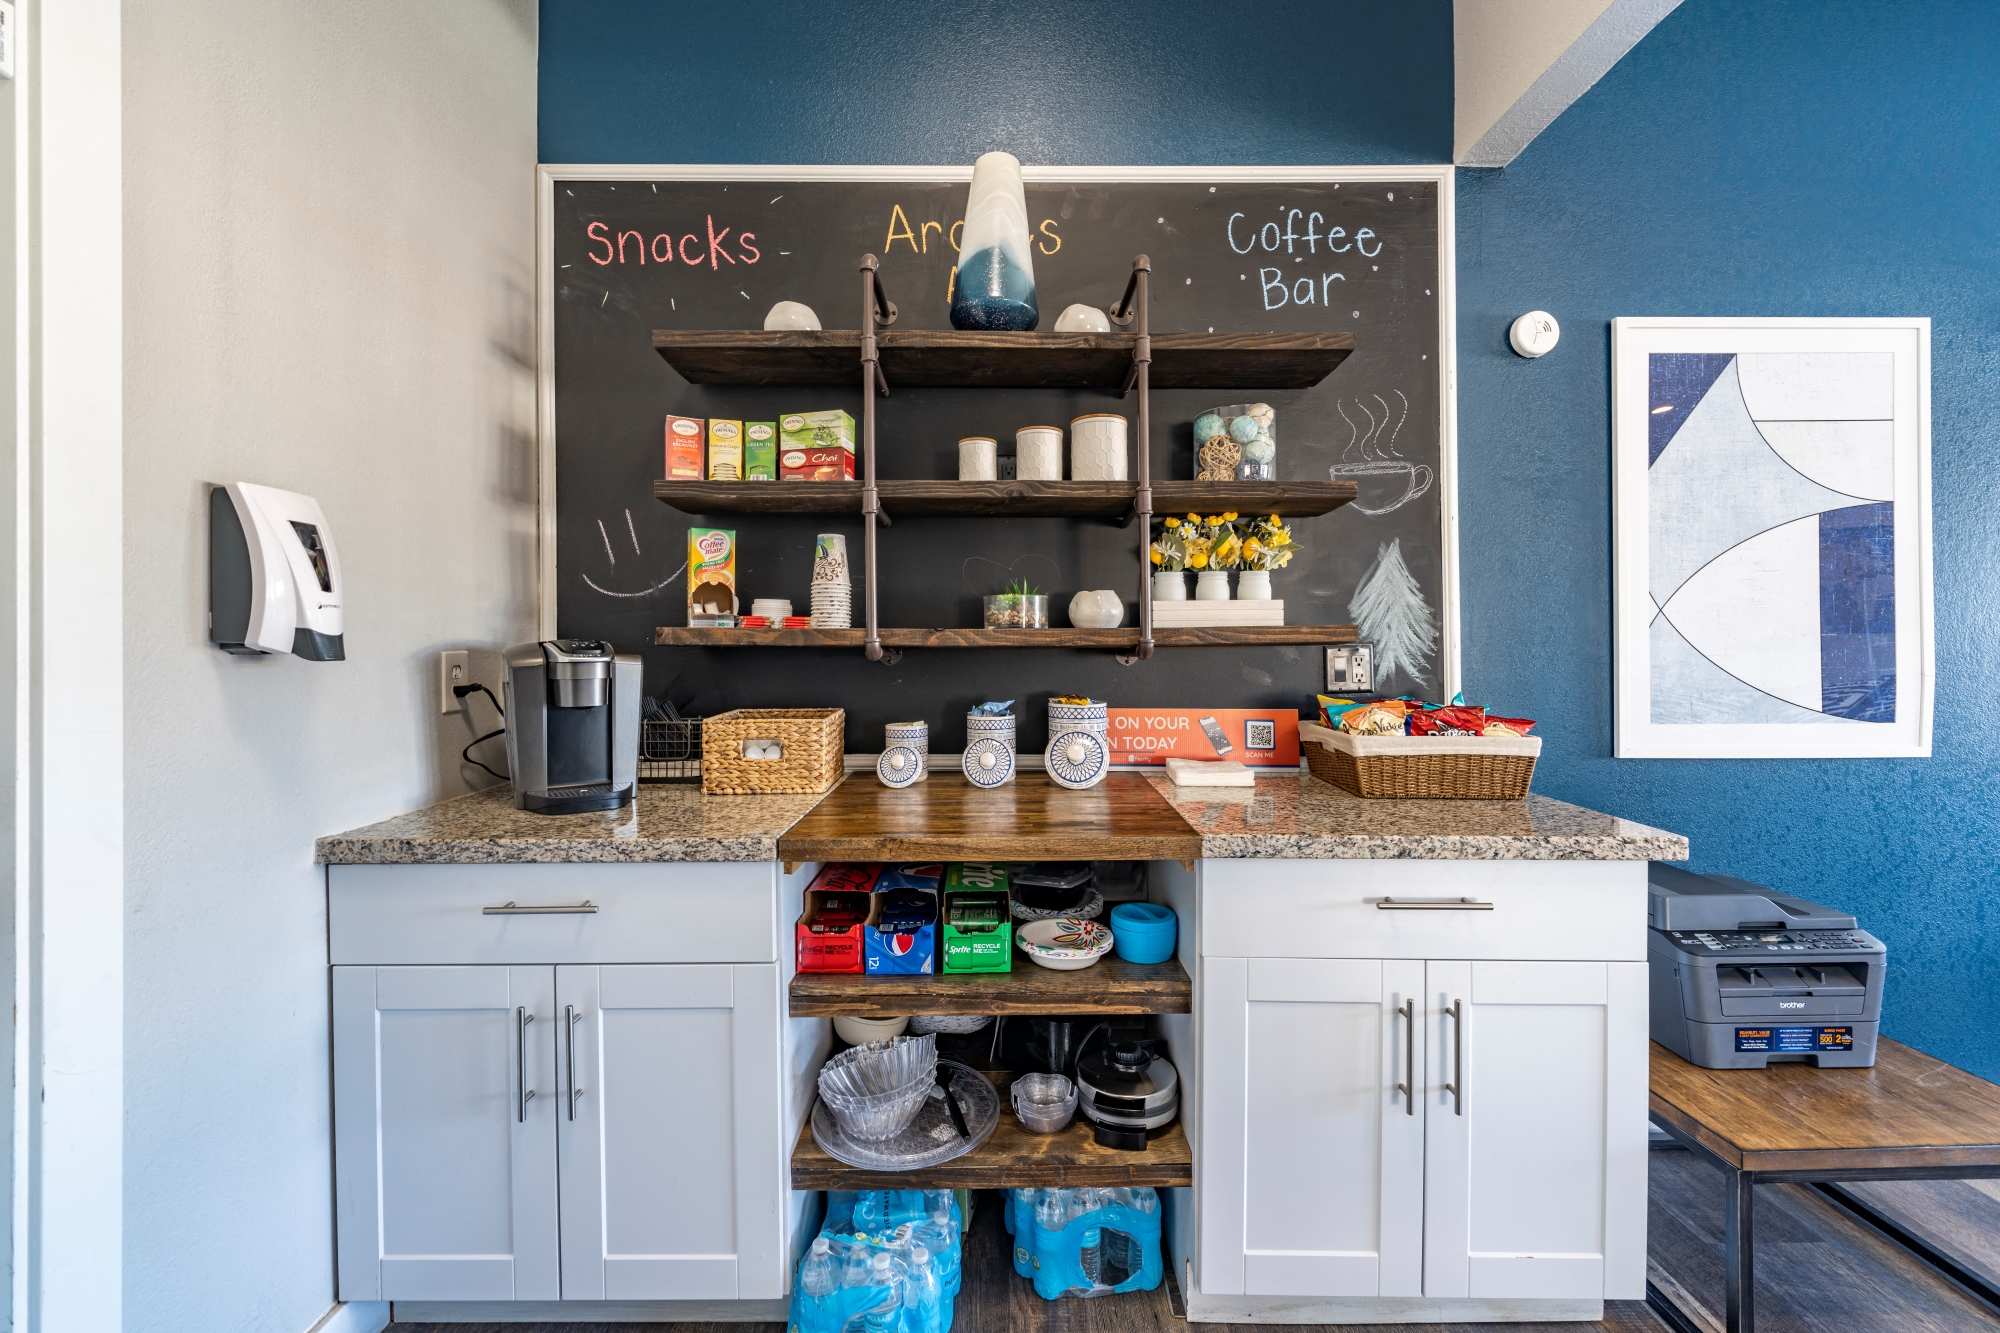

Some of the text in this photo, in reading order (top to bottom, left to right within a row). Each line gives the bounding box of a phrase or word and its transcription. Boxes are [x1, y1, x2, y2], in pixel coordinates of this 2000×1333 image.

[1228, 209, 1383, 257] Coffee
[587, 215, 761, 271] Snacks
[1260, 267, 1345, 311] Bar
[812, 453, 838, 463] Chai
[699, 538, 725, 551] Coffee
[705, 547, 723, 555] mate
[1115, 716, 1140, 730] ON
[1144, 716, 1190, 730] YOUR
[1122, 736, 1178, 750] TODAY
[949, 945, 972, 955] Sprite
[868, 956, 880, 966] 12
[1779, 1001, 1806, 1009] brother
[1835, 1034, 1842, 1043] 2
